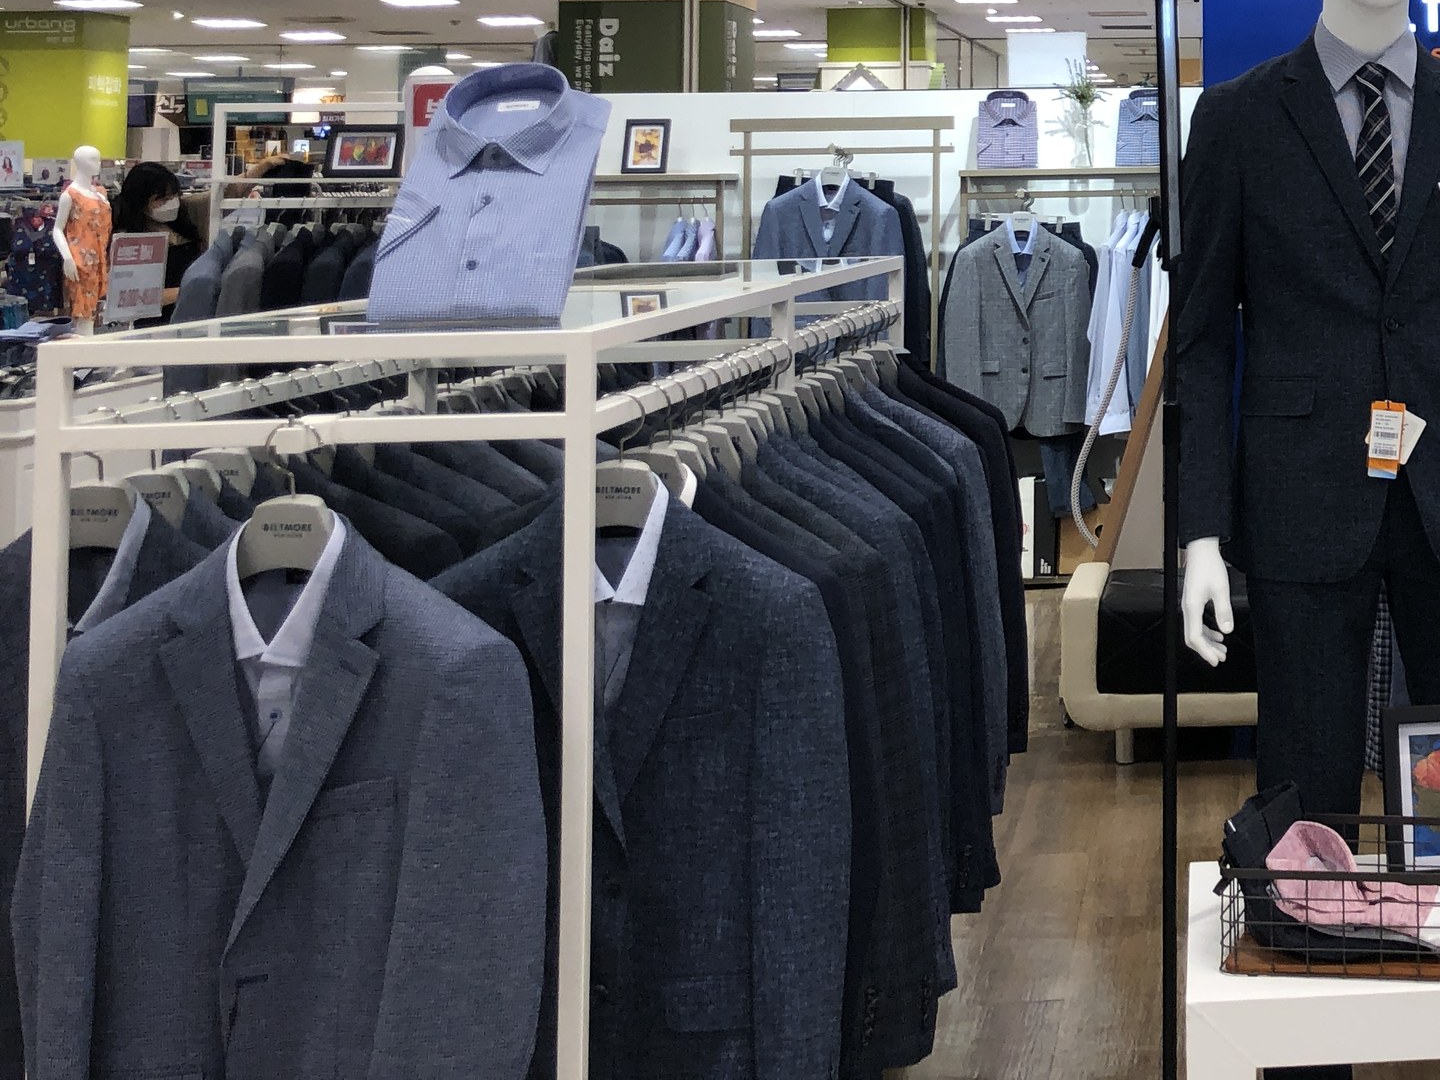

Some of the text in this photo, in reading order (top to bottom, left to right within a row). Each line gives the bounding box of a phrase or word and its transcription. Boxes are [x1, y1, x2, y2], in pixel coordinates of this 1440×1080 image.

[584, 19, 593, 62] Featuring
[598, 18, 622, 78] Daiz
[263, 523, 312, 533] BILTMORE
